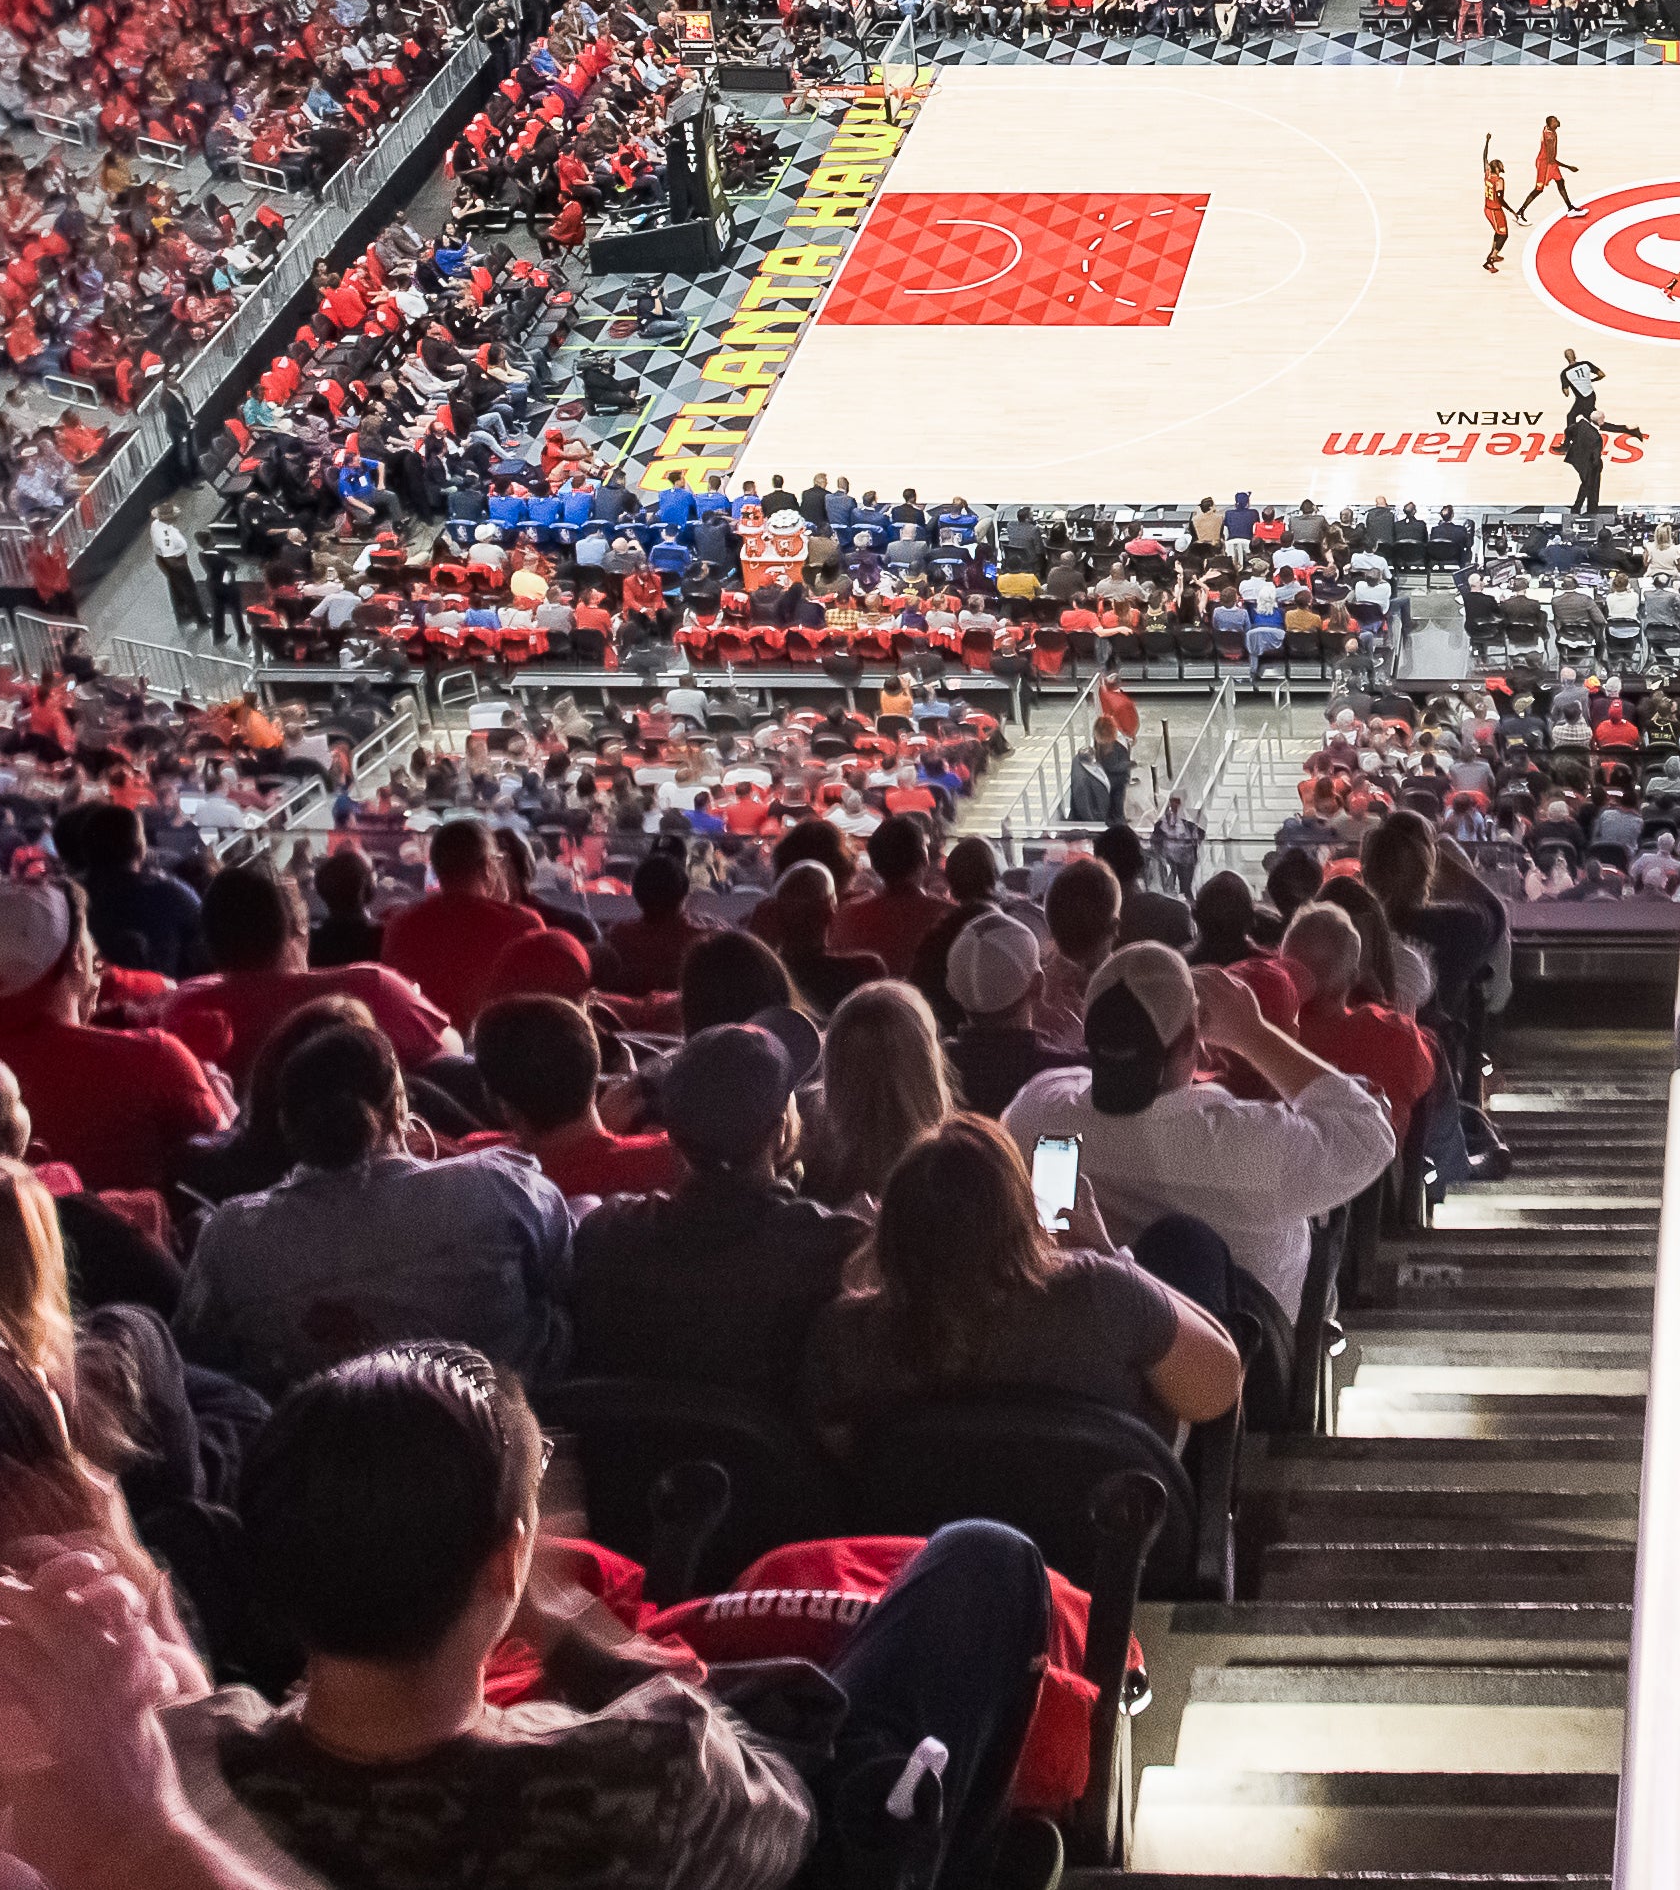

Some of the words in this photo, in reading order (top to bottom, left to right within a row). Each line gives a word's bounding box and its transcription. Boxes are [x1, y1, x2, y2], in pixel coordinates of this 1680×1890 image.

[684, 122, 695, 151] NBA
[686, 153, 698, 173] TV
[1575, 367, 1584, 378] 11
[1436, 411, 1544, 425] ARENA
